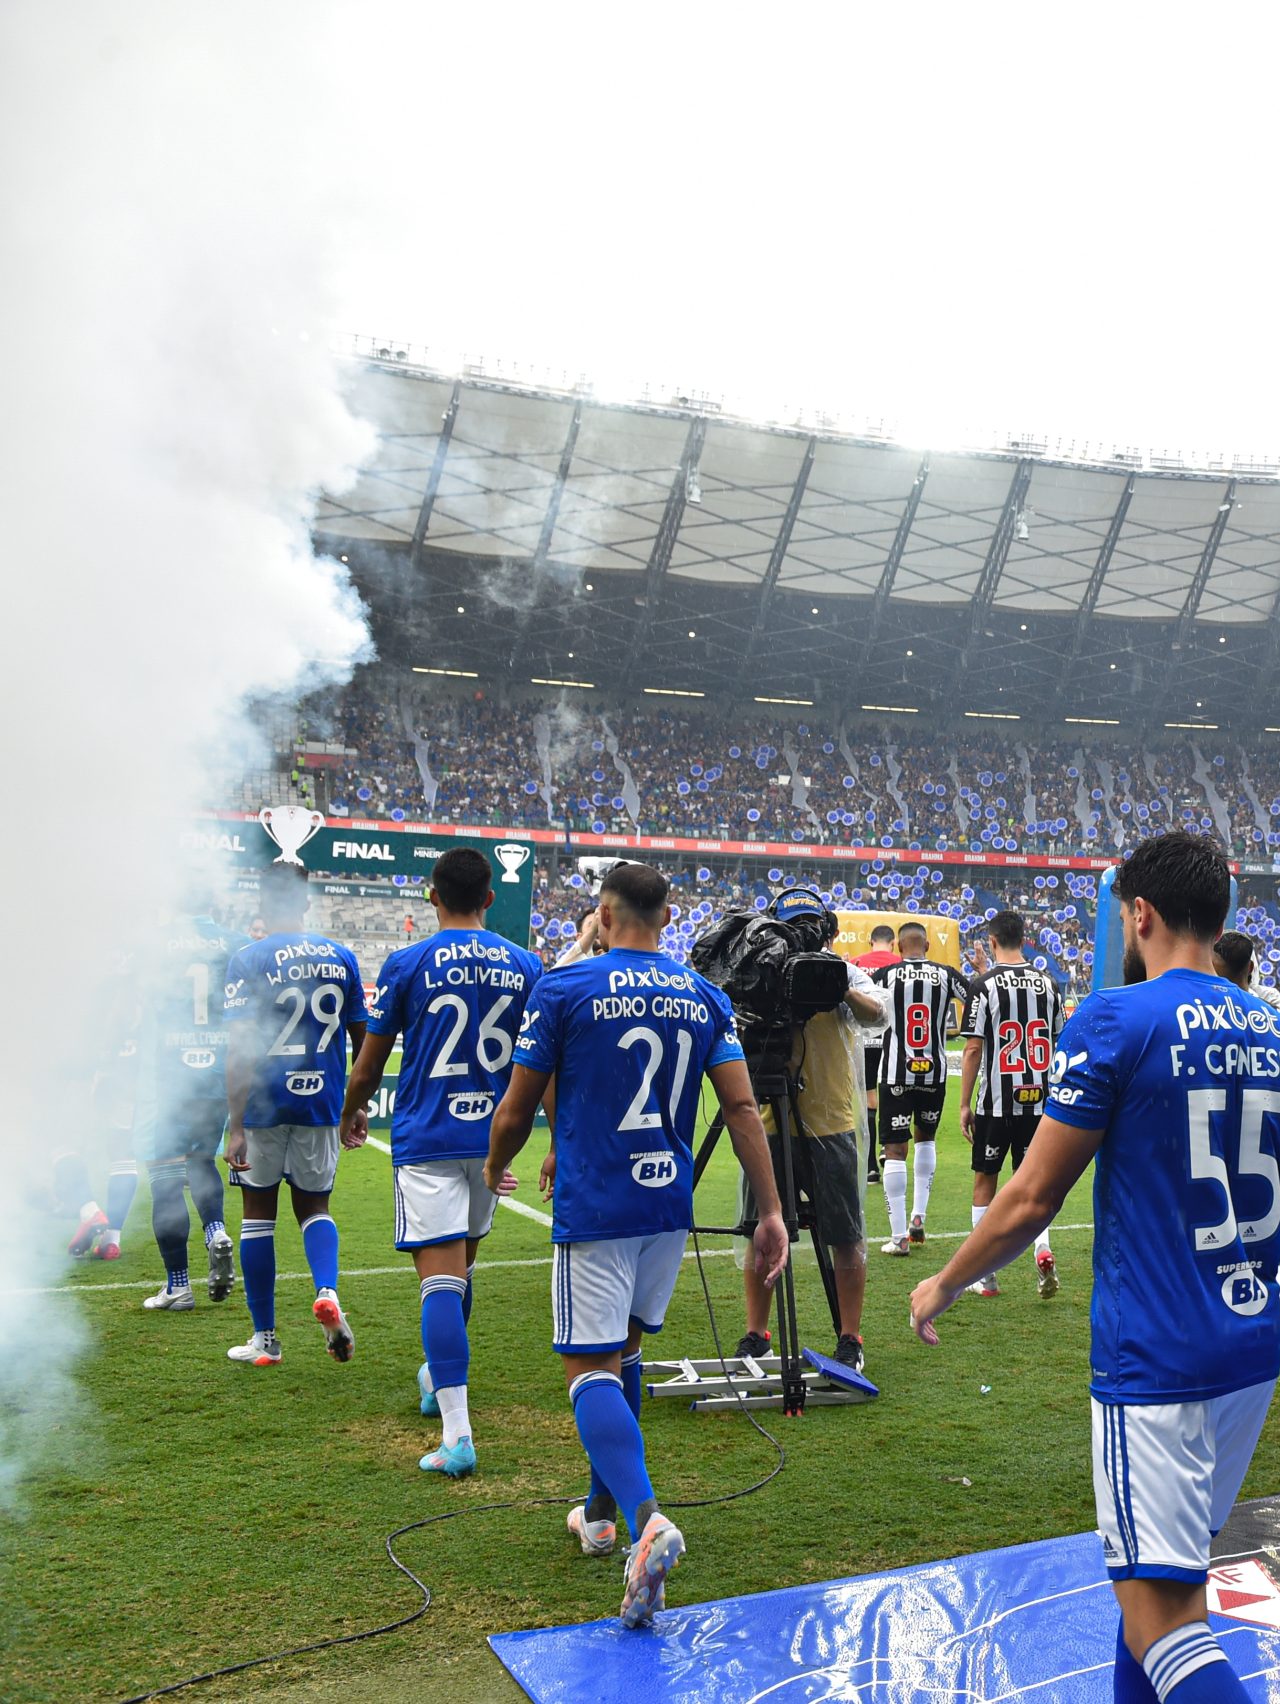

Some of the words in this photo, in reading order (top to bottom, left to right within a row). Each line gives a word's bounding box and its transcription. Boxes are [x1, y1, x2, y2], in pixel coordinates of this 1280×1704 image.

[180, 833, 246, 852] FINAL
[332, 841, 396, 861] FINAL
[238, 881, 260, 890] FINA
[324, 885, 351, 894] FINAL
[167, 936, 228, 952] pixbet
[274, 940, 337, 966] pixbet
[434, 938, 512, 967] pixbet
[266, 970, 287, 986] W.
[288, 963, 347, 980] OLIVEIRA
[424, 970, 444, 989] L.
[446, 966, 525, 992] OLIVEIRA
[608, 966, 697, 994] pixbet
[908, 969, 940, 985] bmg
[185, 963, 208, 1025] 1
[1010, 977, 1044, 993] bmg
[223, 996, 249, 1009] user
[593, 995, 647, 1021] PEDRO
[651, 996, 709, 1024] CASTRO
[969, 995, 980, 1018] MRV
[267, 983, 345, 1056] 29
[906, 1003, 931, 1050] 8
[427, 993, 515, 1079] 26
[998, 1018, 1051, 1075] 26
[911, 1061, 930, 1072] BH
[1170, 1044, 1196, 1077] F.
[291, 1078, 320, 1090] BH
[616, 1026, 693, 1132] 21
[1019, 1089, 1040, 1101] BH
[1050, 1085, 1085, 1106] ser
[455, 1099, 490, 1115] BH
[891, 1114, 911, 1127] abc
[985, 1144, 1000, 1157] bc
[638, 1161, 673, 1181] BH
